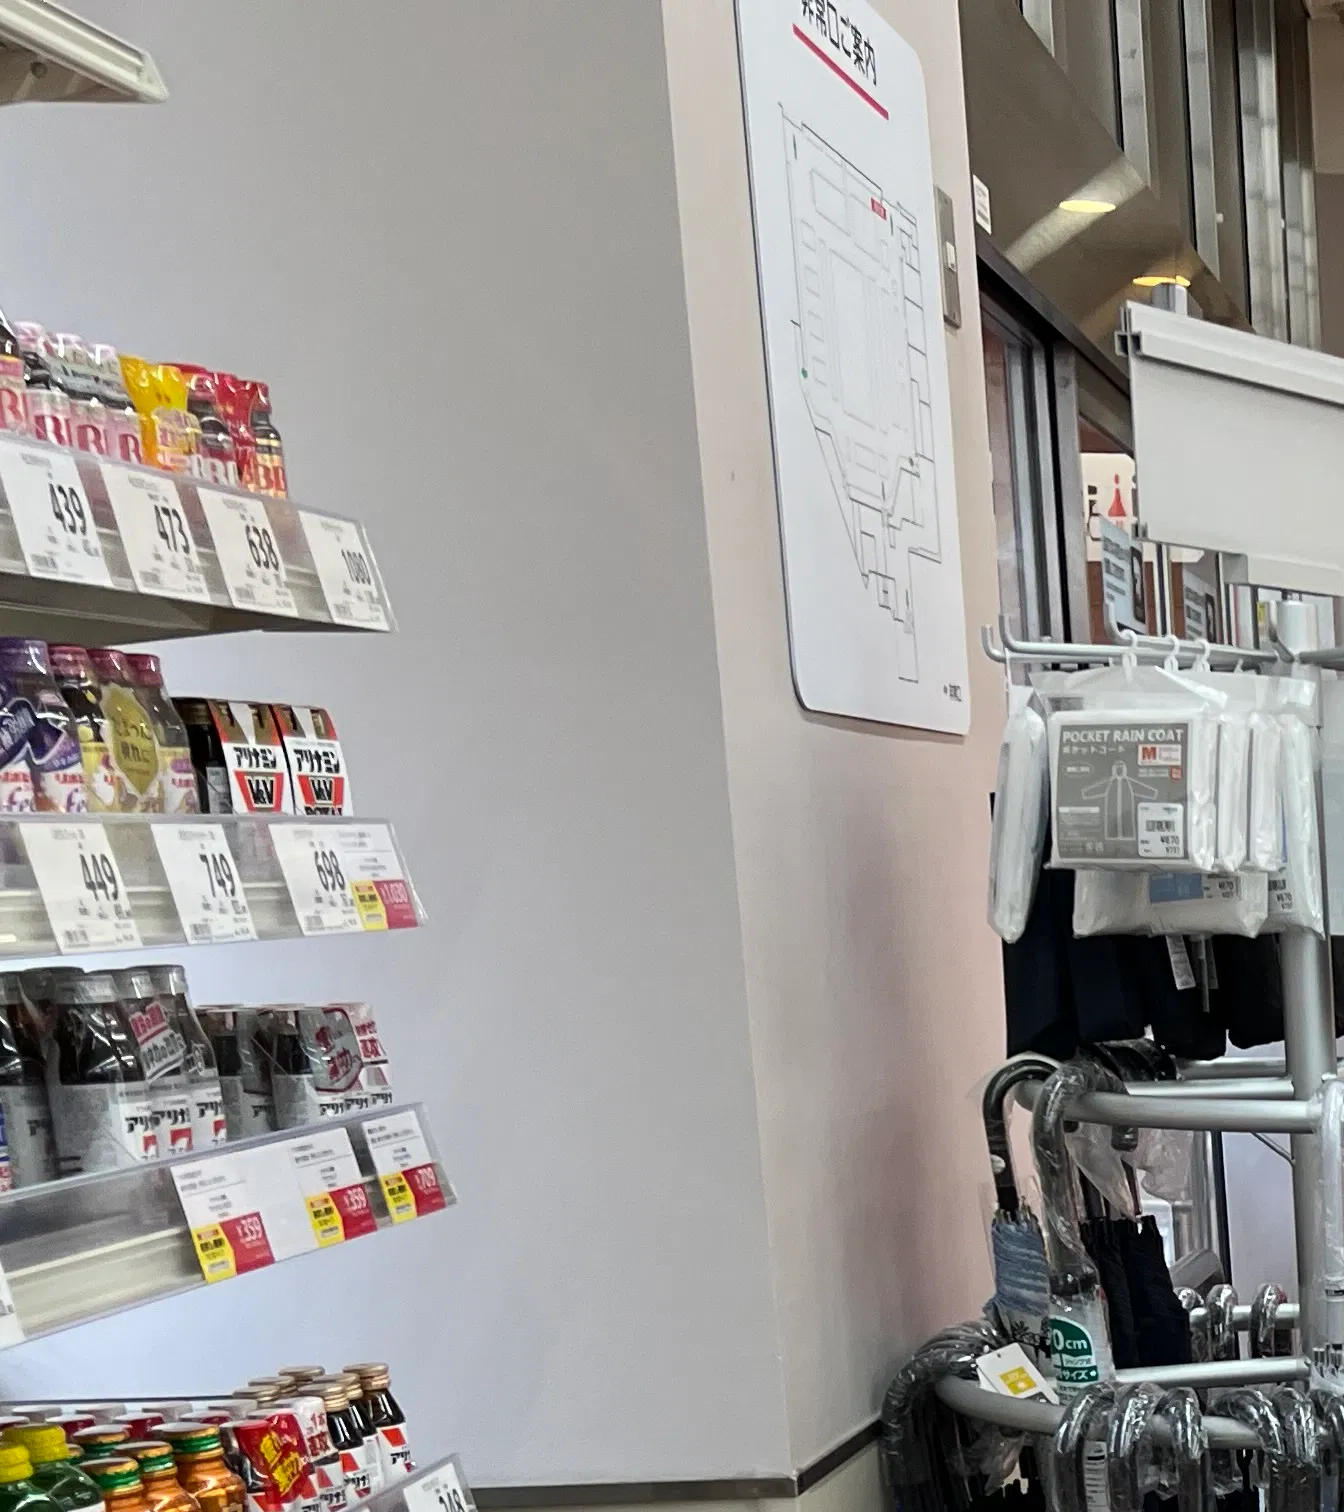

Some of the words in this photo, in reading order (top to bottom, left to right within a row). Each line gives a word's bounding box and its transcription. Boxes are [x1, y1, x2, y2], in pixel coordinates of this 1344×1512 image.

[50, 483, 87, 535] 439
[155, 505, 191, 554] 473
[246, 526, 280, 571] 638
[1062, 729, 1110, 744] POCKET
[1113, 729, 1146, 743] RAIN
[1147, 729, 1184, 743] COAT
[80, 856, 118, 901] 449
[200, 853, 236, 898] 749
[314, 851, 346, 892] 698
